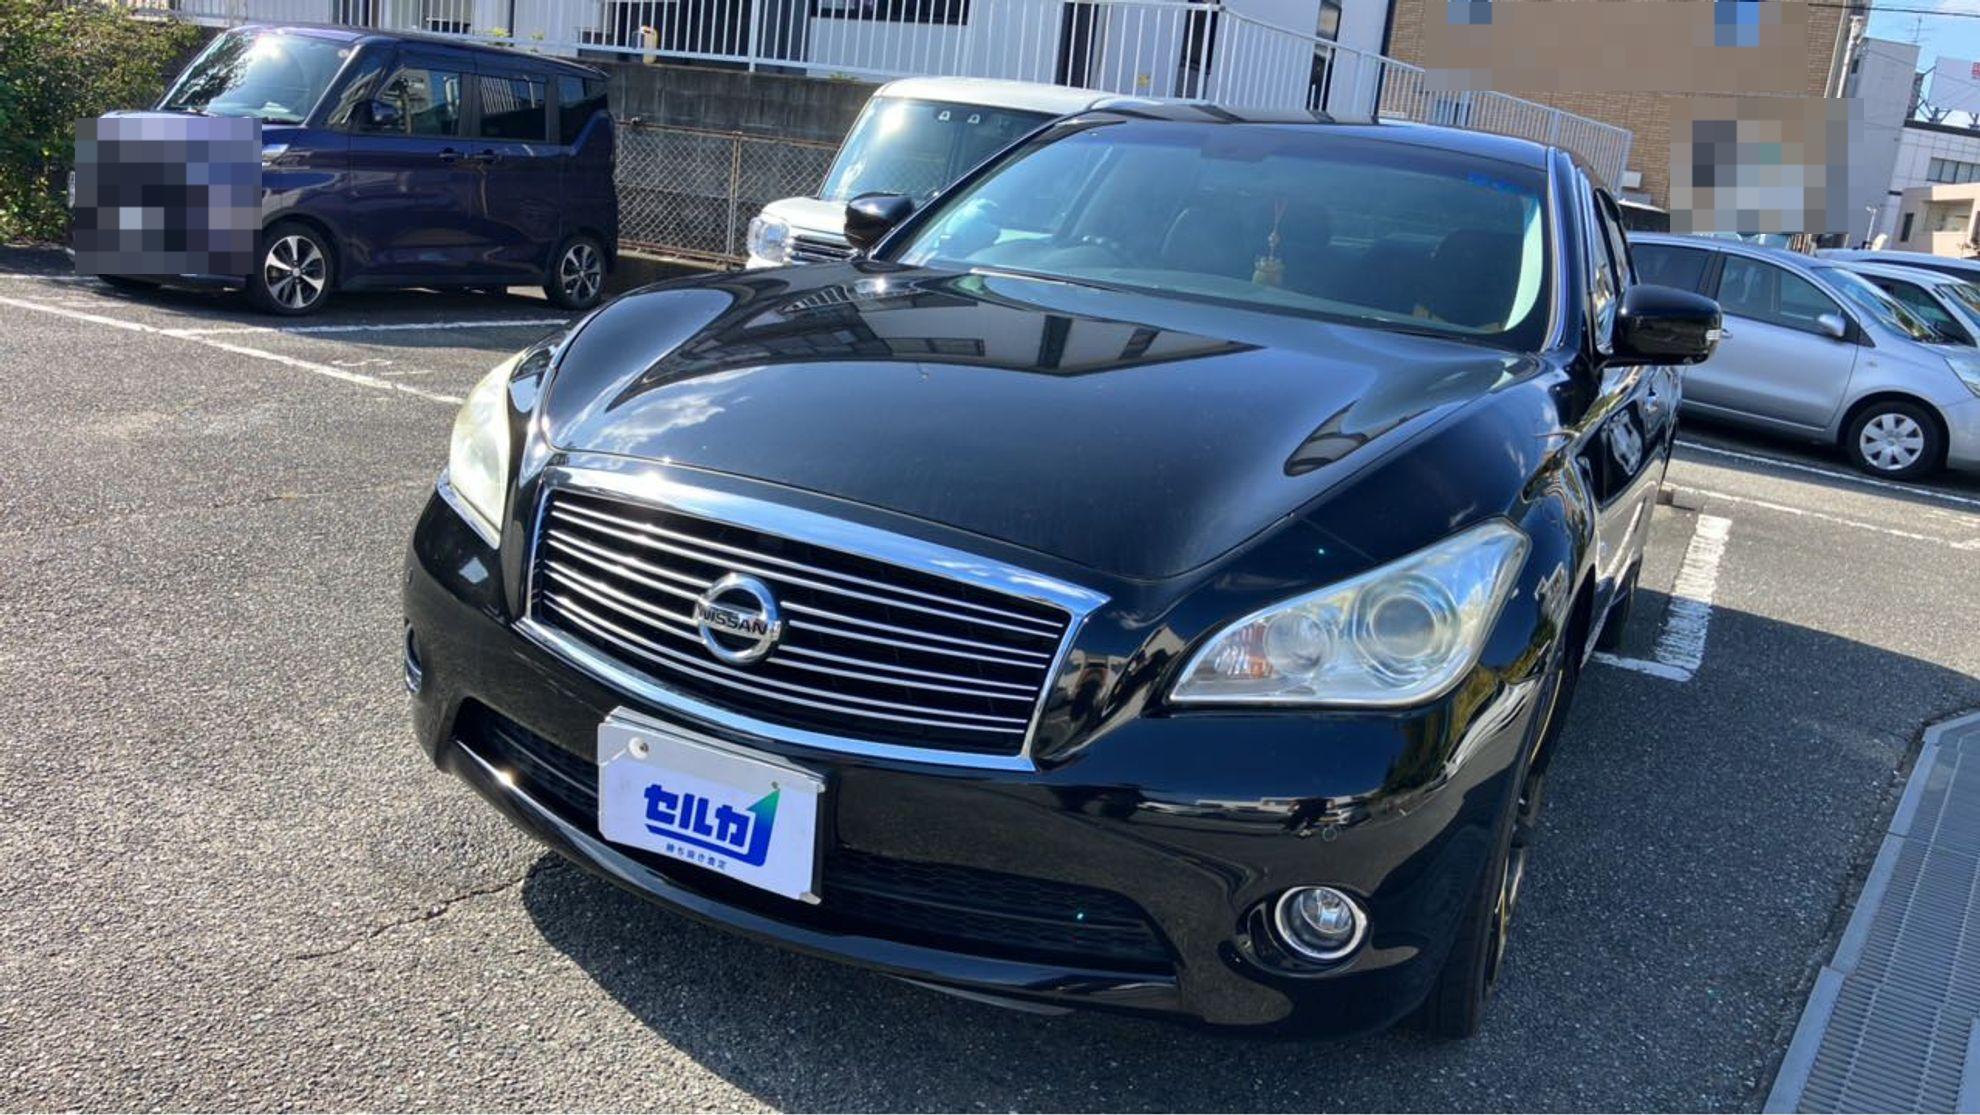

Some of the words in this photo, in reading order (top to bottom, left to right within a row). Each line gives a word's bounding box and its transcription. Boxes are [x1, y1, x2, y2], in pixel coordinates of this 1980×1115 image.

[699, 606, 768, 635] NISSAN
[644, 784, 751, 848] セルカ
